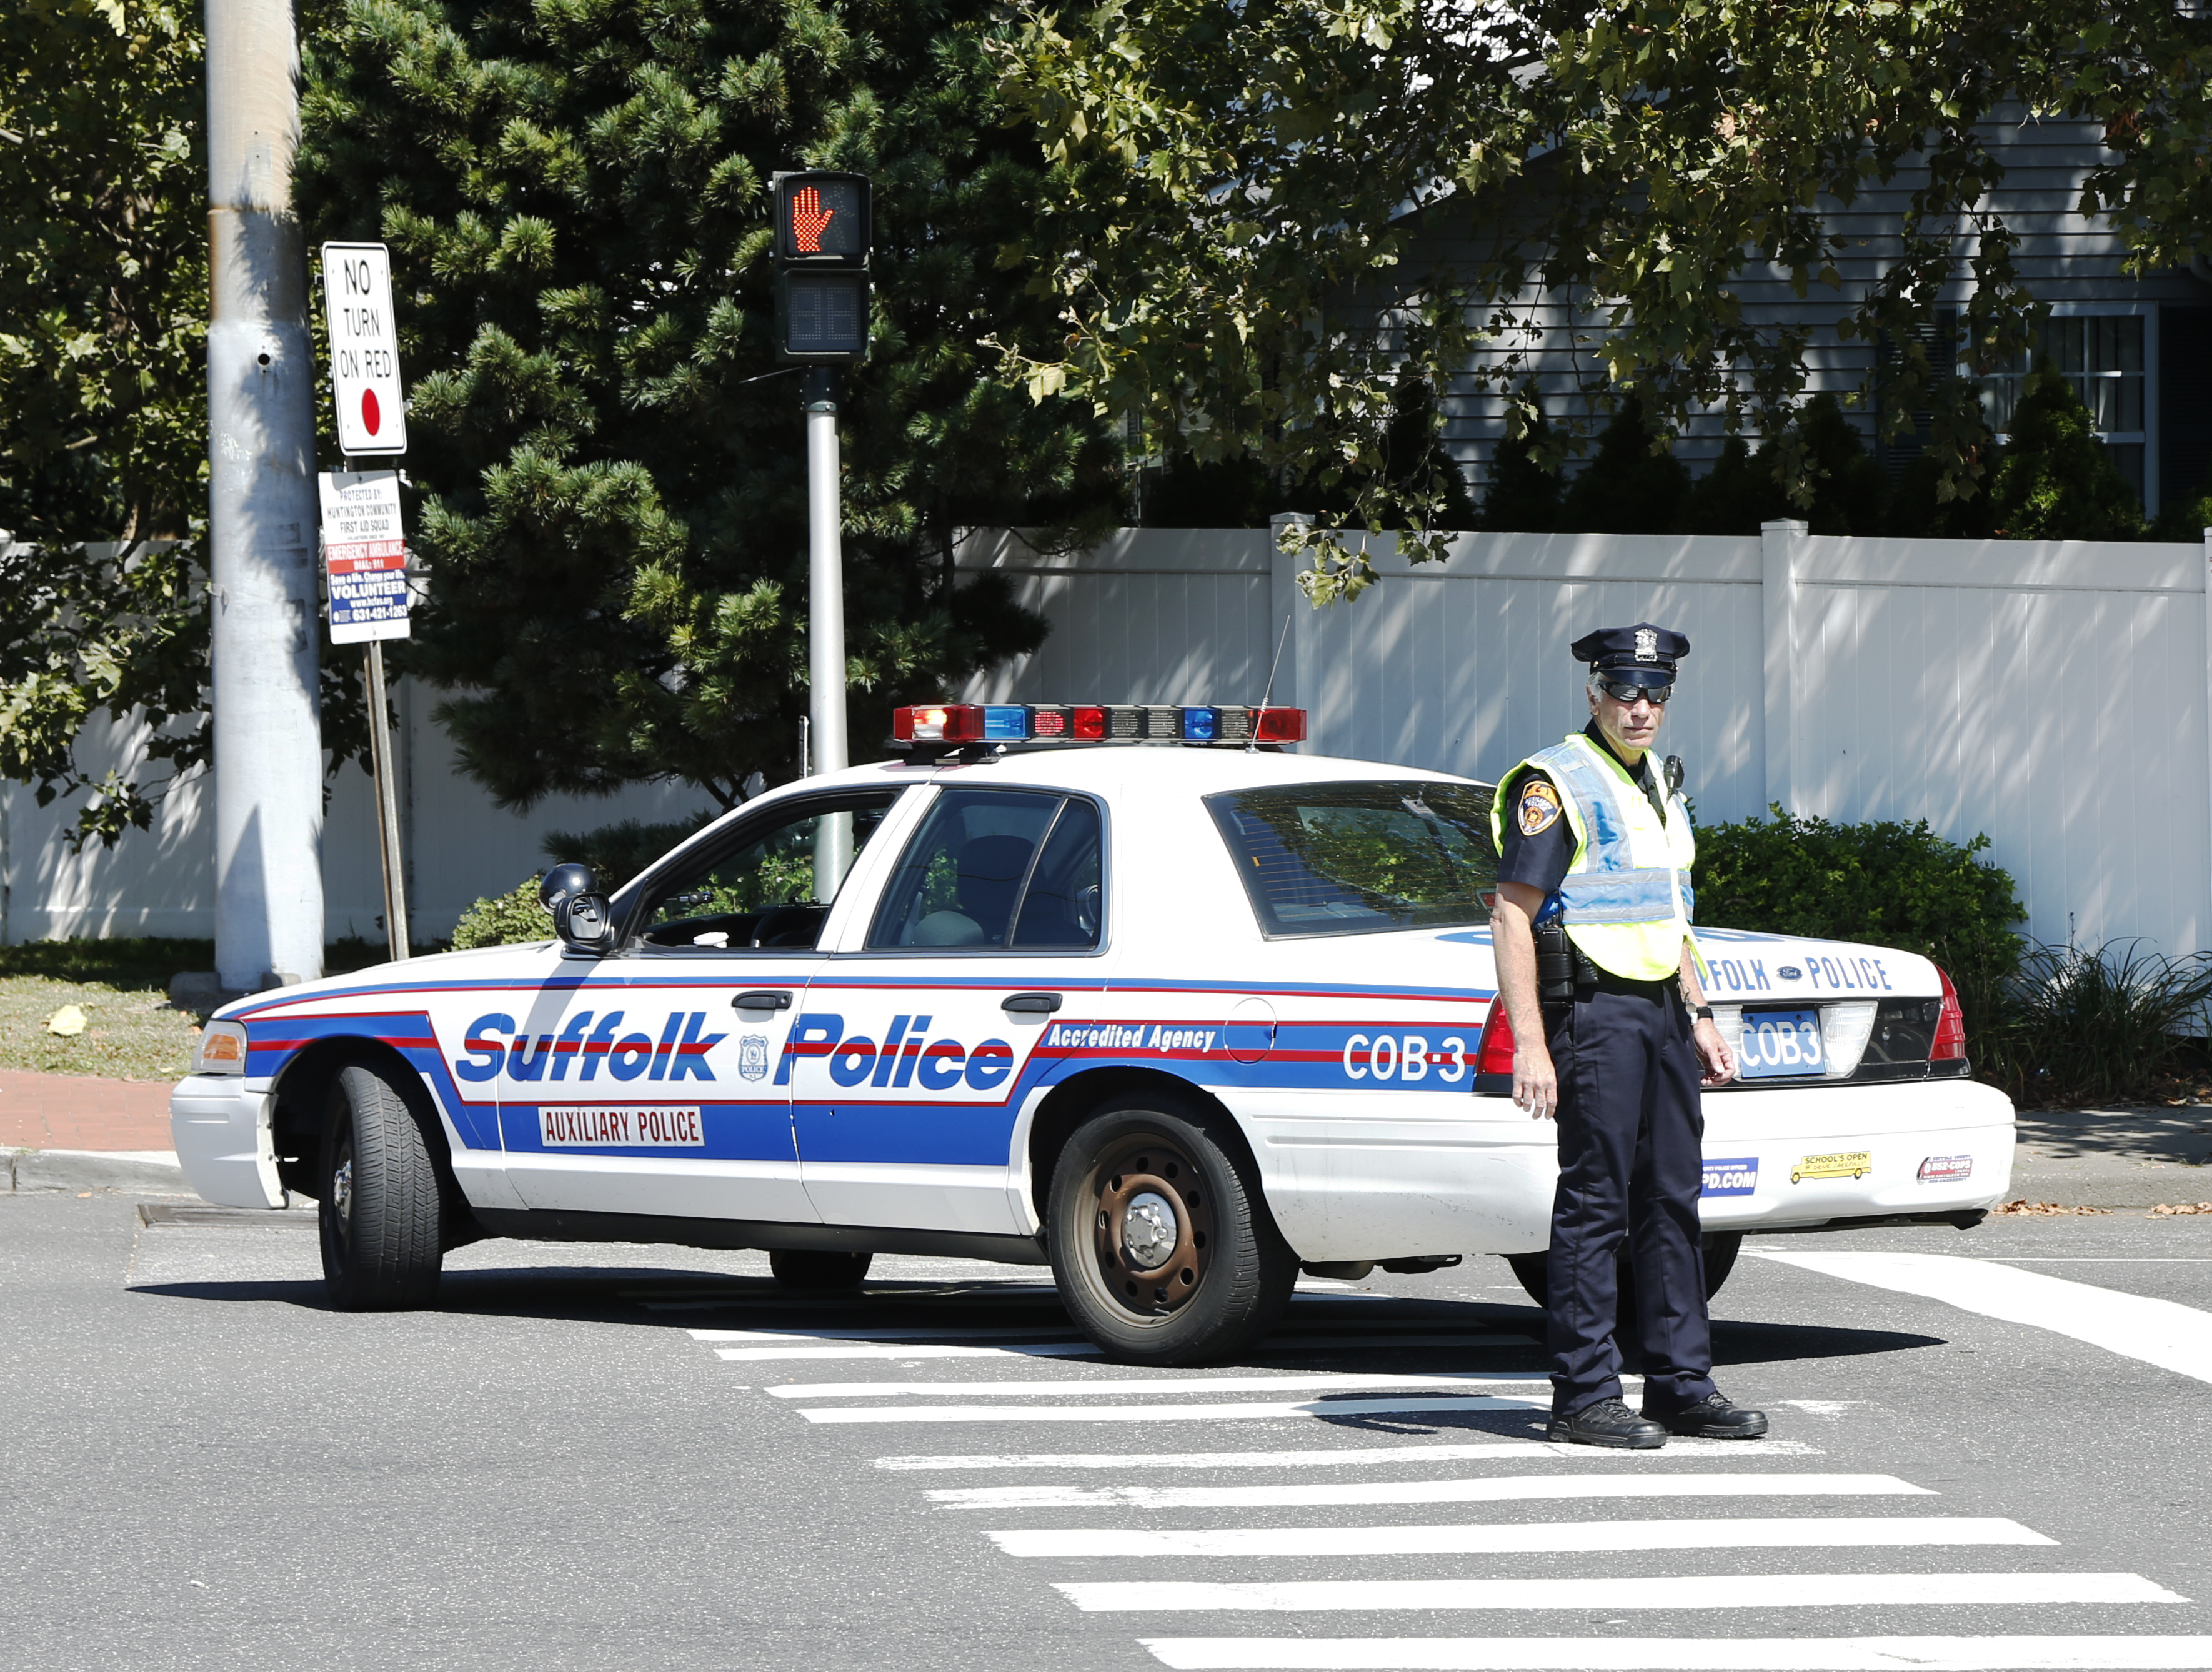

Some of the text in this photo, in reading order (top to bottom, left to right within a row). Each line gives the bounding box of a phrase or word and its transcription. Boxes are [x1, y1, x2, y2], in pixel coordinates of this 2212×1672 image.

[344, 259, 371, 296] NO
[343, 308, 381, 337] TURN
[340, 349, 391, 379] ON RED
[340, 489, 382, 502] PROTECTED BY:
[327, 503, 396, 519] HUNTINGTON COMMUNITY
[340, 519, 389, 534] FIRST AID SQUAD
[327, 540, 404, 562] EMERGENCY AMBULANCE
[354, 558, 384, 571] DIAL: 911
[330, 574, 346, 585] Save
[347, 575, 351, 584] a
[331, 580, 406, 600] VOLUNTEER
[1694, 957, 1893, 991] FOLK POLICE
[1047, 1023, 1216, 1053] Accredited Agency
[1740, 1021, 1821, 1067] COB3
[455, 1010, 1014, 1090] Suffolk Police
[546, 1110, 700, 1143] AUXILIARY POLICE
[1805, 1153, 1867, 1164] SCHOOL'S OPEN
[1931, 1160, 1971, 1172] 852-COPS
